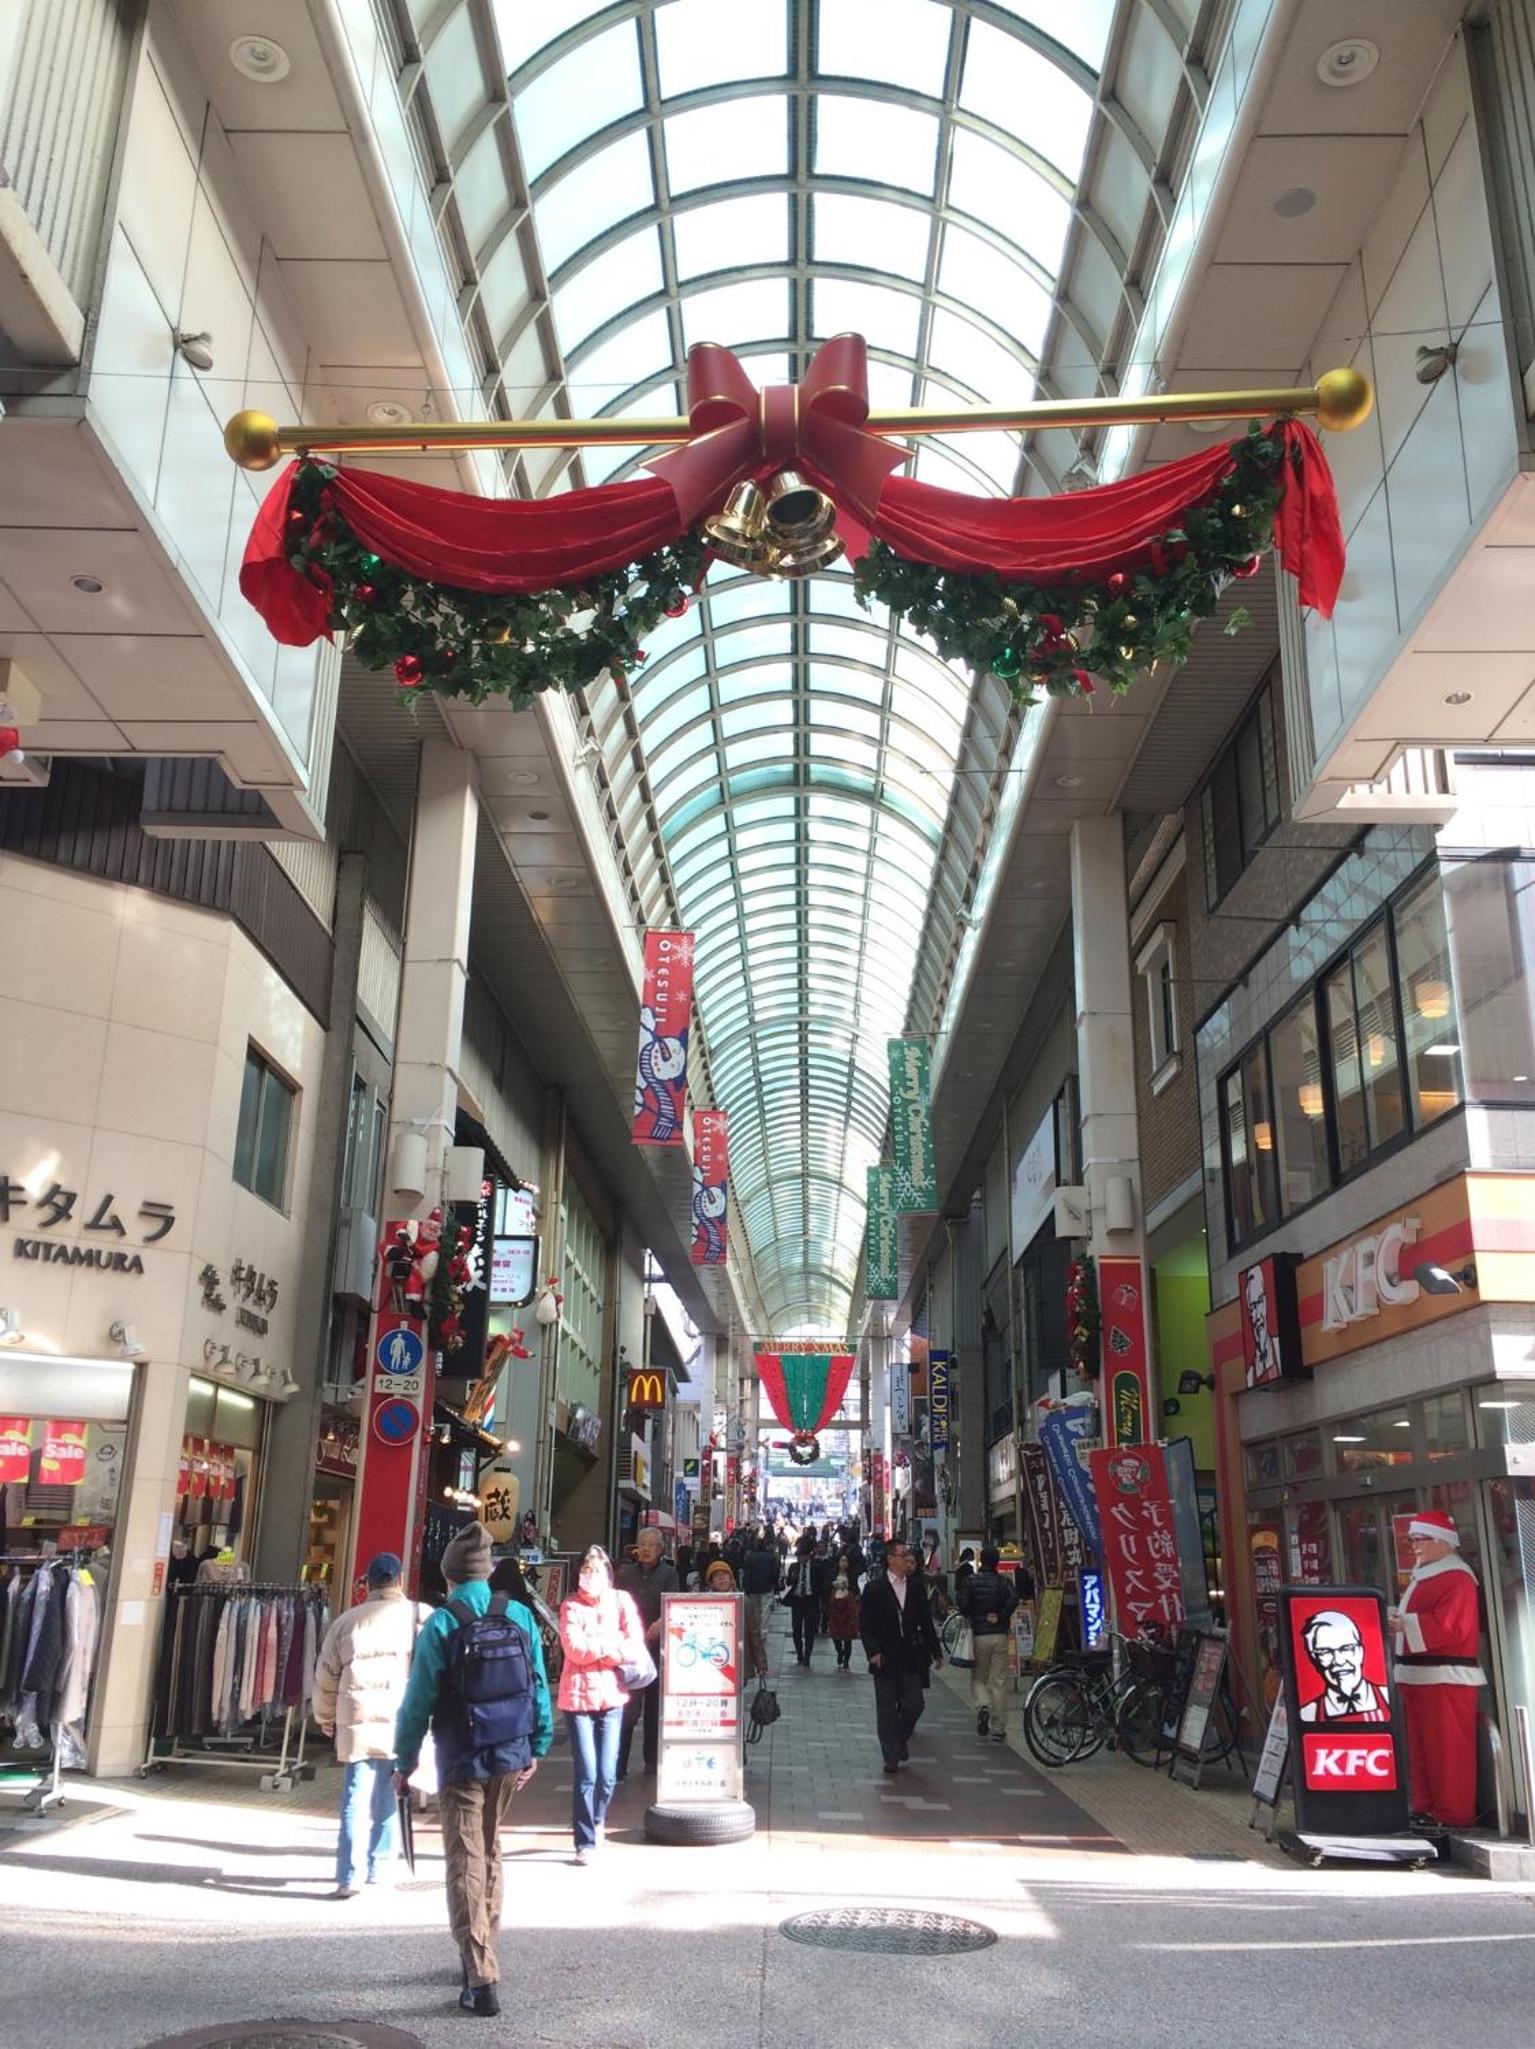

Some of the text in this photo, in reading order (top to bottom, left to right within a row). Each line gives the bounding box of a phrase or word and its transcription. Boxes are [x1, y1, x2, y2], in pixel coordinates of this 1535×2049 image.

[655, 939, 671, 1024] OTESUJI
[0, 1176, 176, 1243] キタムラ
[13, 1238, 144, 1274] KITAMURA
[1321, 1217, 1422, 1333] KFC
[761, 1341, 807, 1354] MERRY
[379, 1378, 419, 1391] 12-20
[931, 1361, 948, 1412] KALDI
[0, 1442, 30, 1457] ale
[45, 1442, 86, 1460] Sale
[1312, 1748, 1390, 1776] KFC
